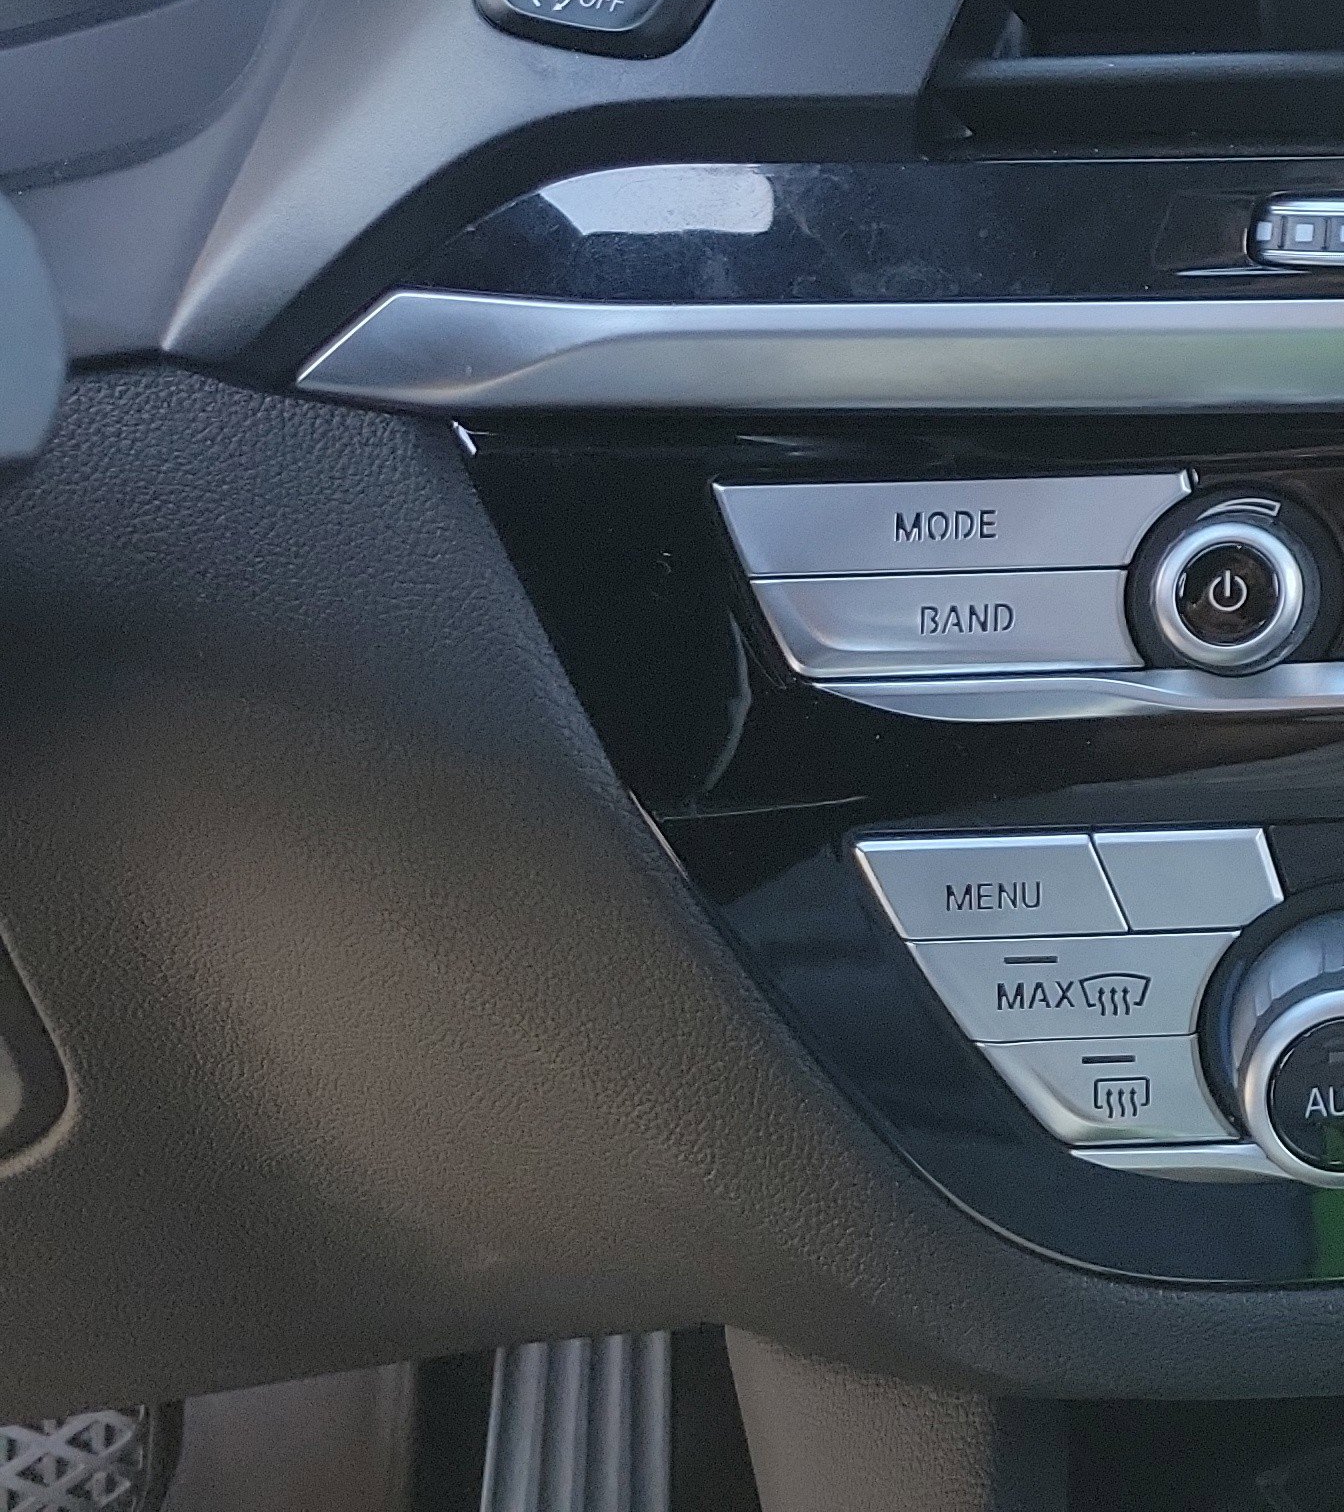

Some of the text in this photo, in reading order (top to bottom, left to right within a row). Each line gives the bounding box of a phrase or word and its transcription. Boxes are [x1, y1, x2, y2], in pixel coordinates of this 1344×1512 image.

[895, 509, 998, 543] MODE
[919, 603, 1016, 635] BAND
[945, 880, 1043, 912] MENU
[996, 982, 1076, 1011] MAX
